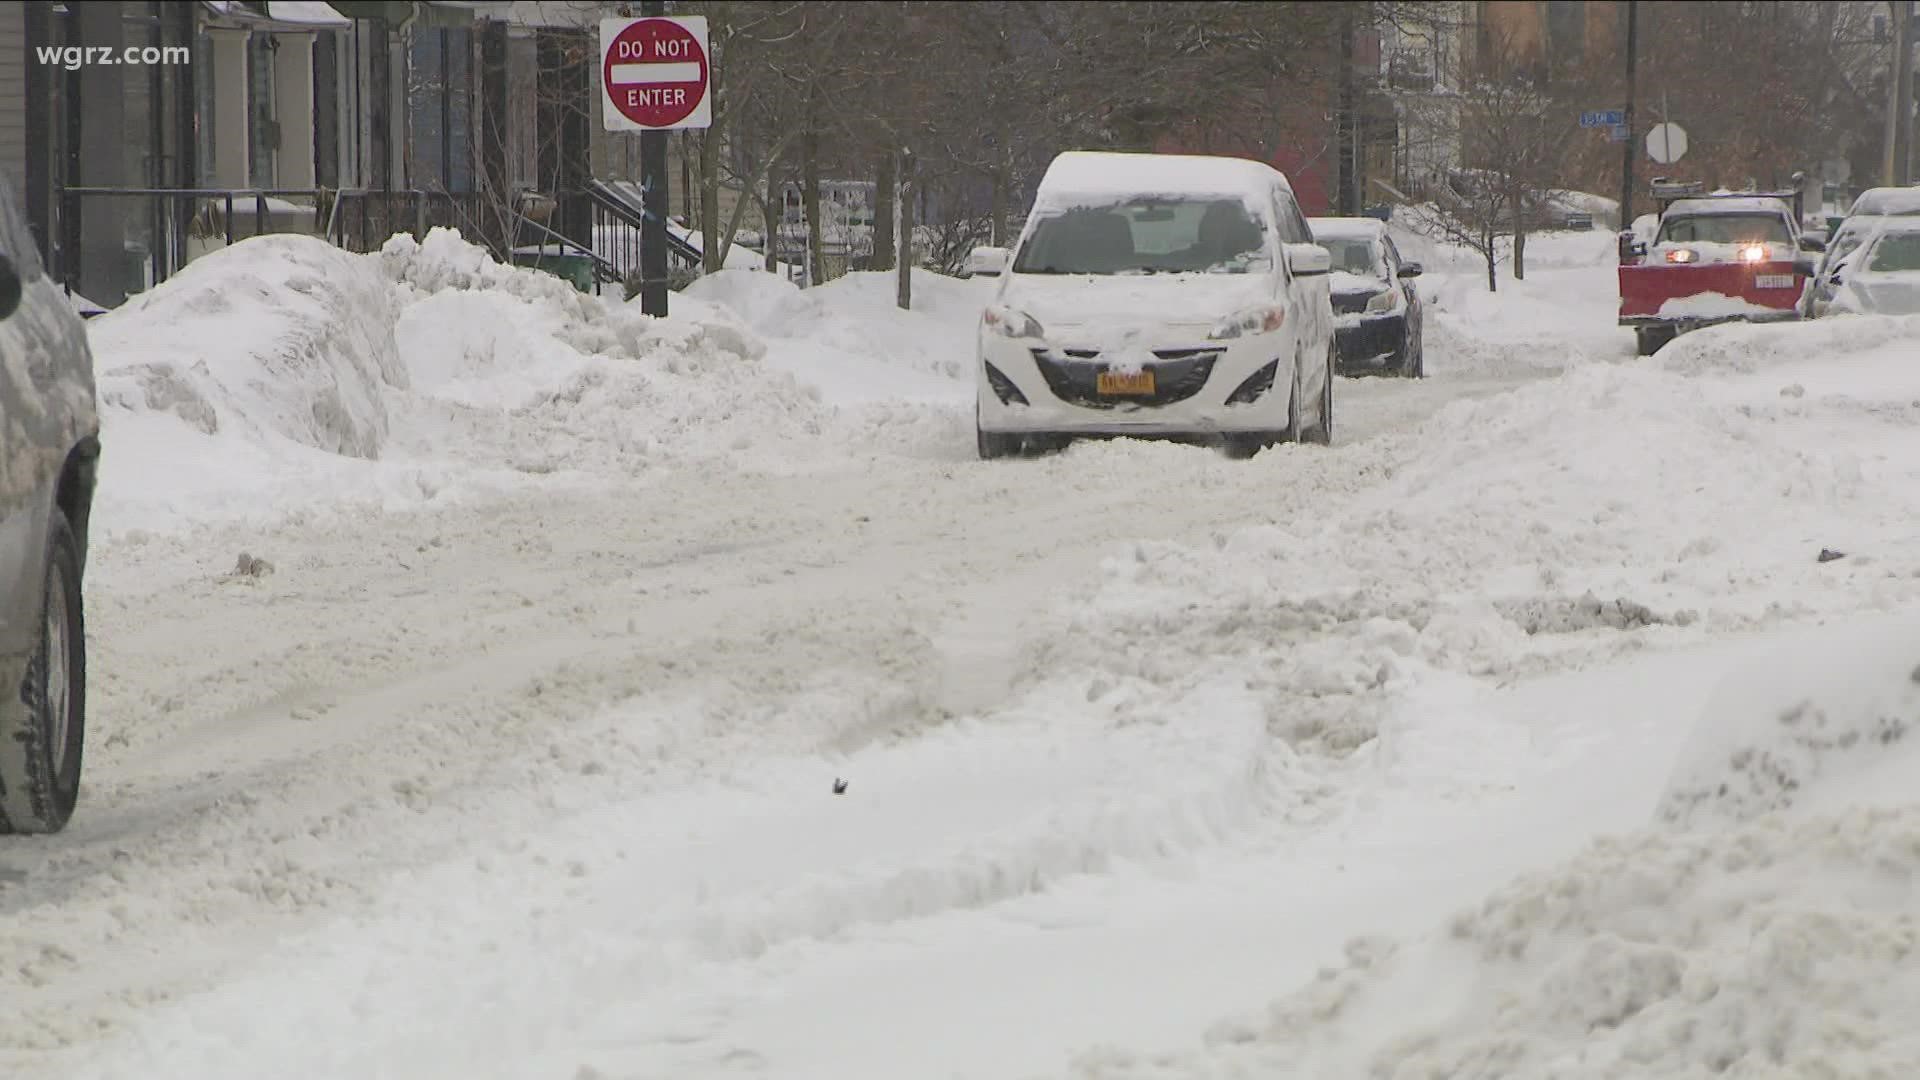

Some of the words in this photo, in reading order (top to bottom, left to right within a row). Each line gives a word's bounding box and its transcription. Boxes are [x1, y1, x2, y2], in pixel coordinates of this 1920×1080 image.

[619, 41, 643, 58] DO
[655, 40, 690, 57] NOT
[628, 89, 686, 107] ENTER
